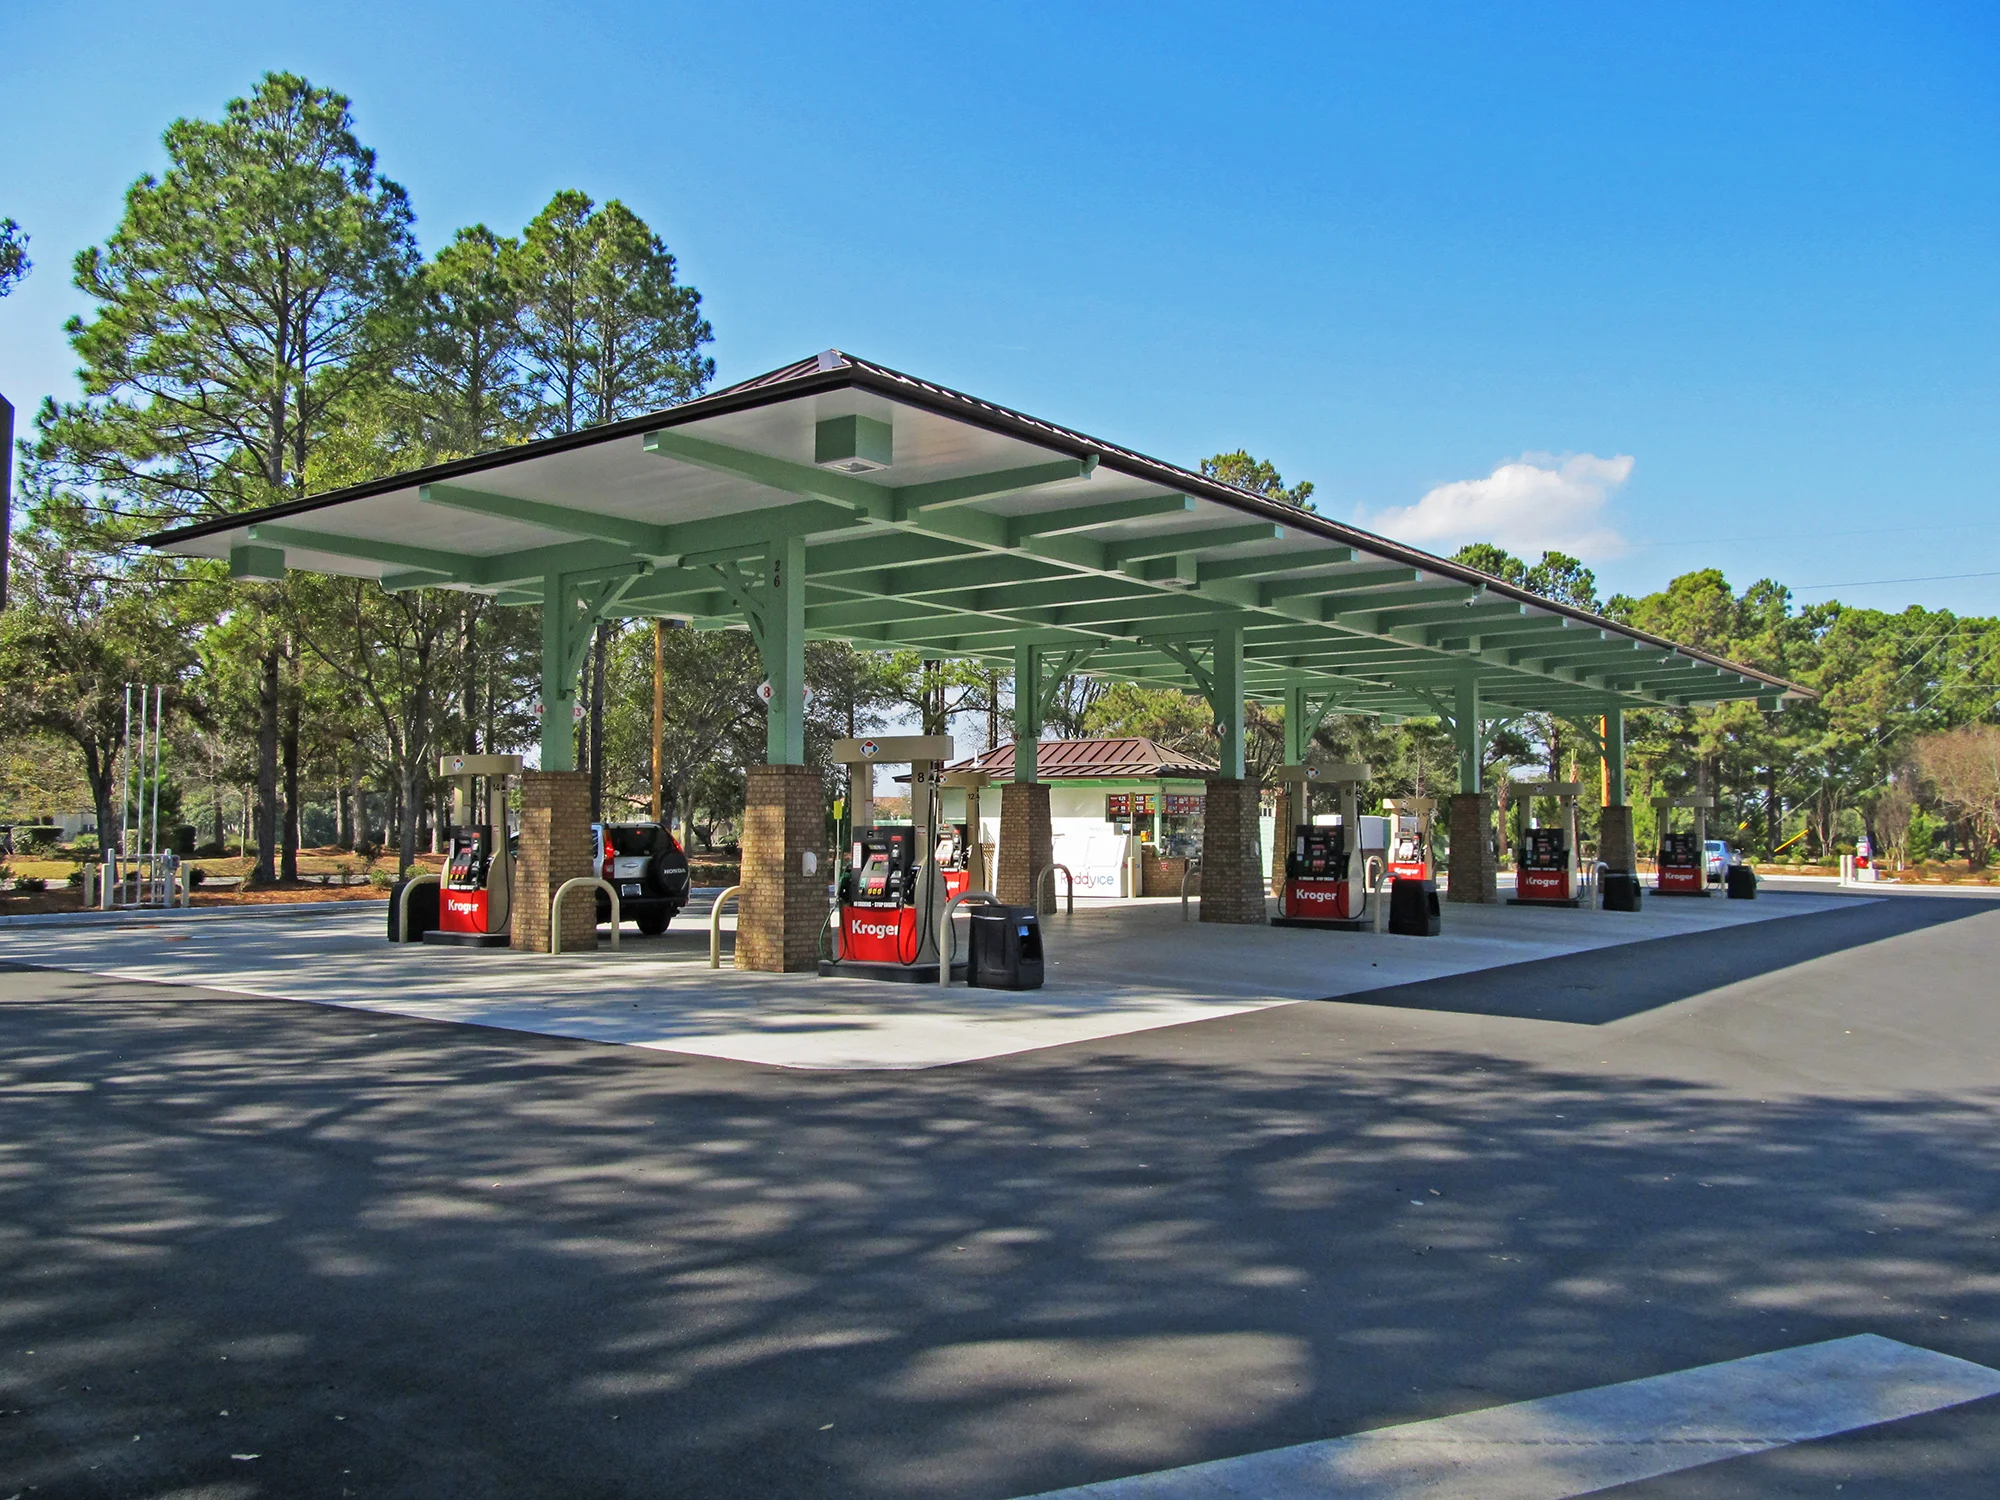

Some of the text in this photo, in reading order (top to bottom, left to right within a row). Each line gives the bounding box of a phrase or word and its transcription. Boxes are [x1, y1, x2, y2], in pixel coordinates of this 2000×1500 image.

[763, 686, 771, 698] 8
[533, 704, 544, 714] 14
[917, 772, 925, 783] 8
[493, 783, 500, 792] 14
[1345, 788, 1351, 797] 6
[1665, 872, 1694, 881] Kroger
[1525, 877, 1560, 888] Kroger
[1296, 889, 1337, 902] Kroger
[448, 899, 479, 915] Kroger
[851, 919, 899, 939] Kroger
